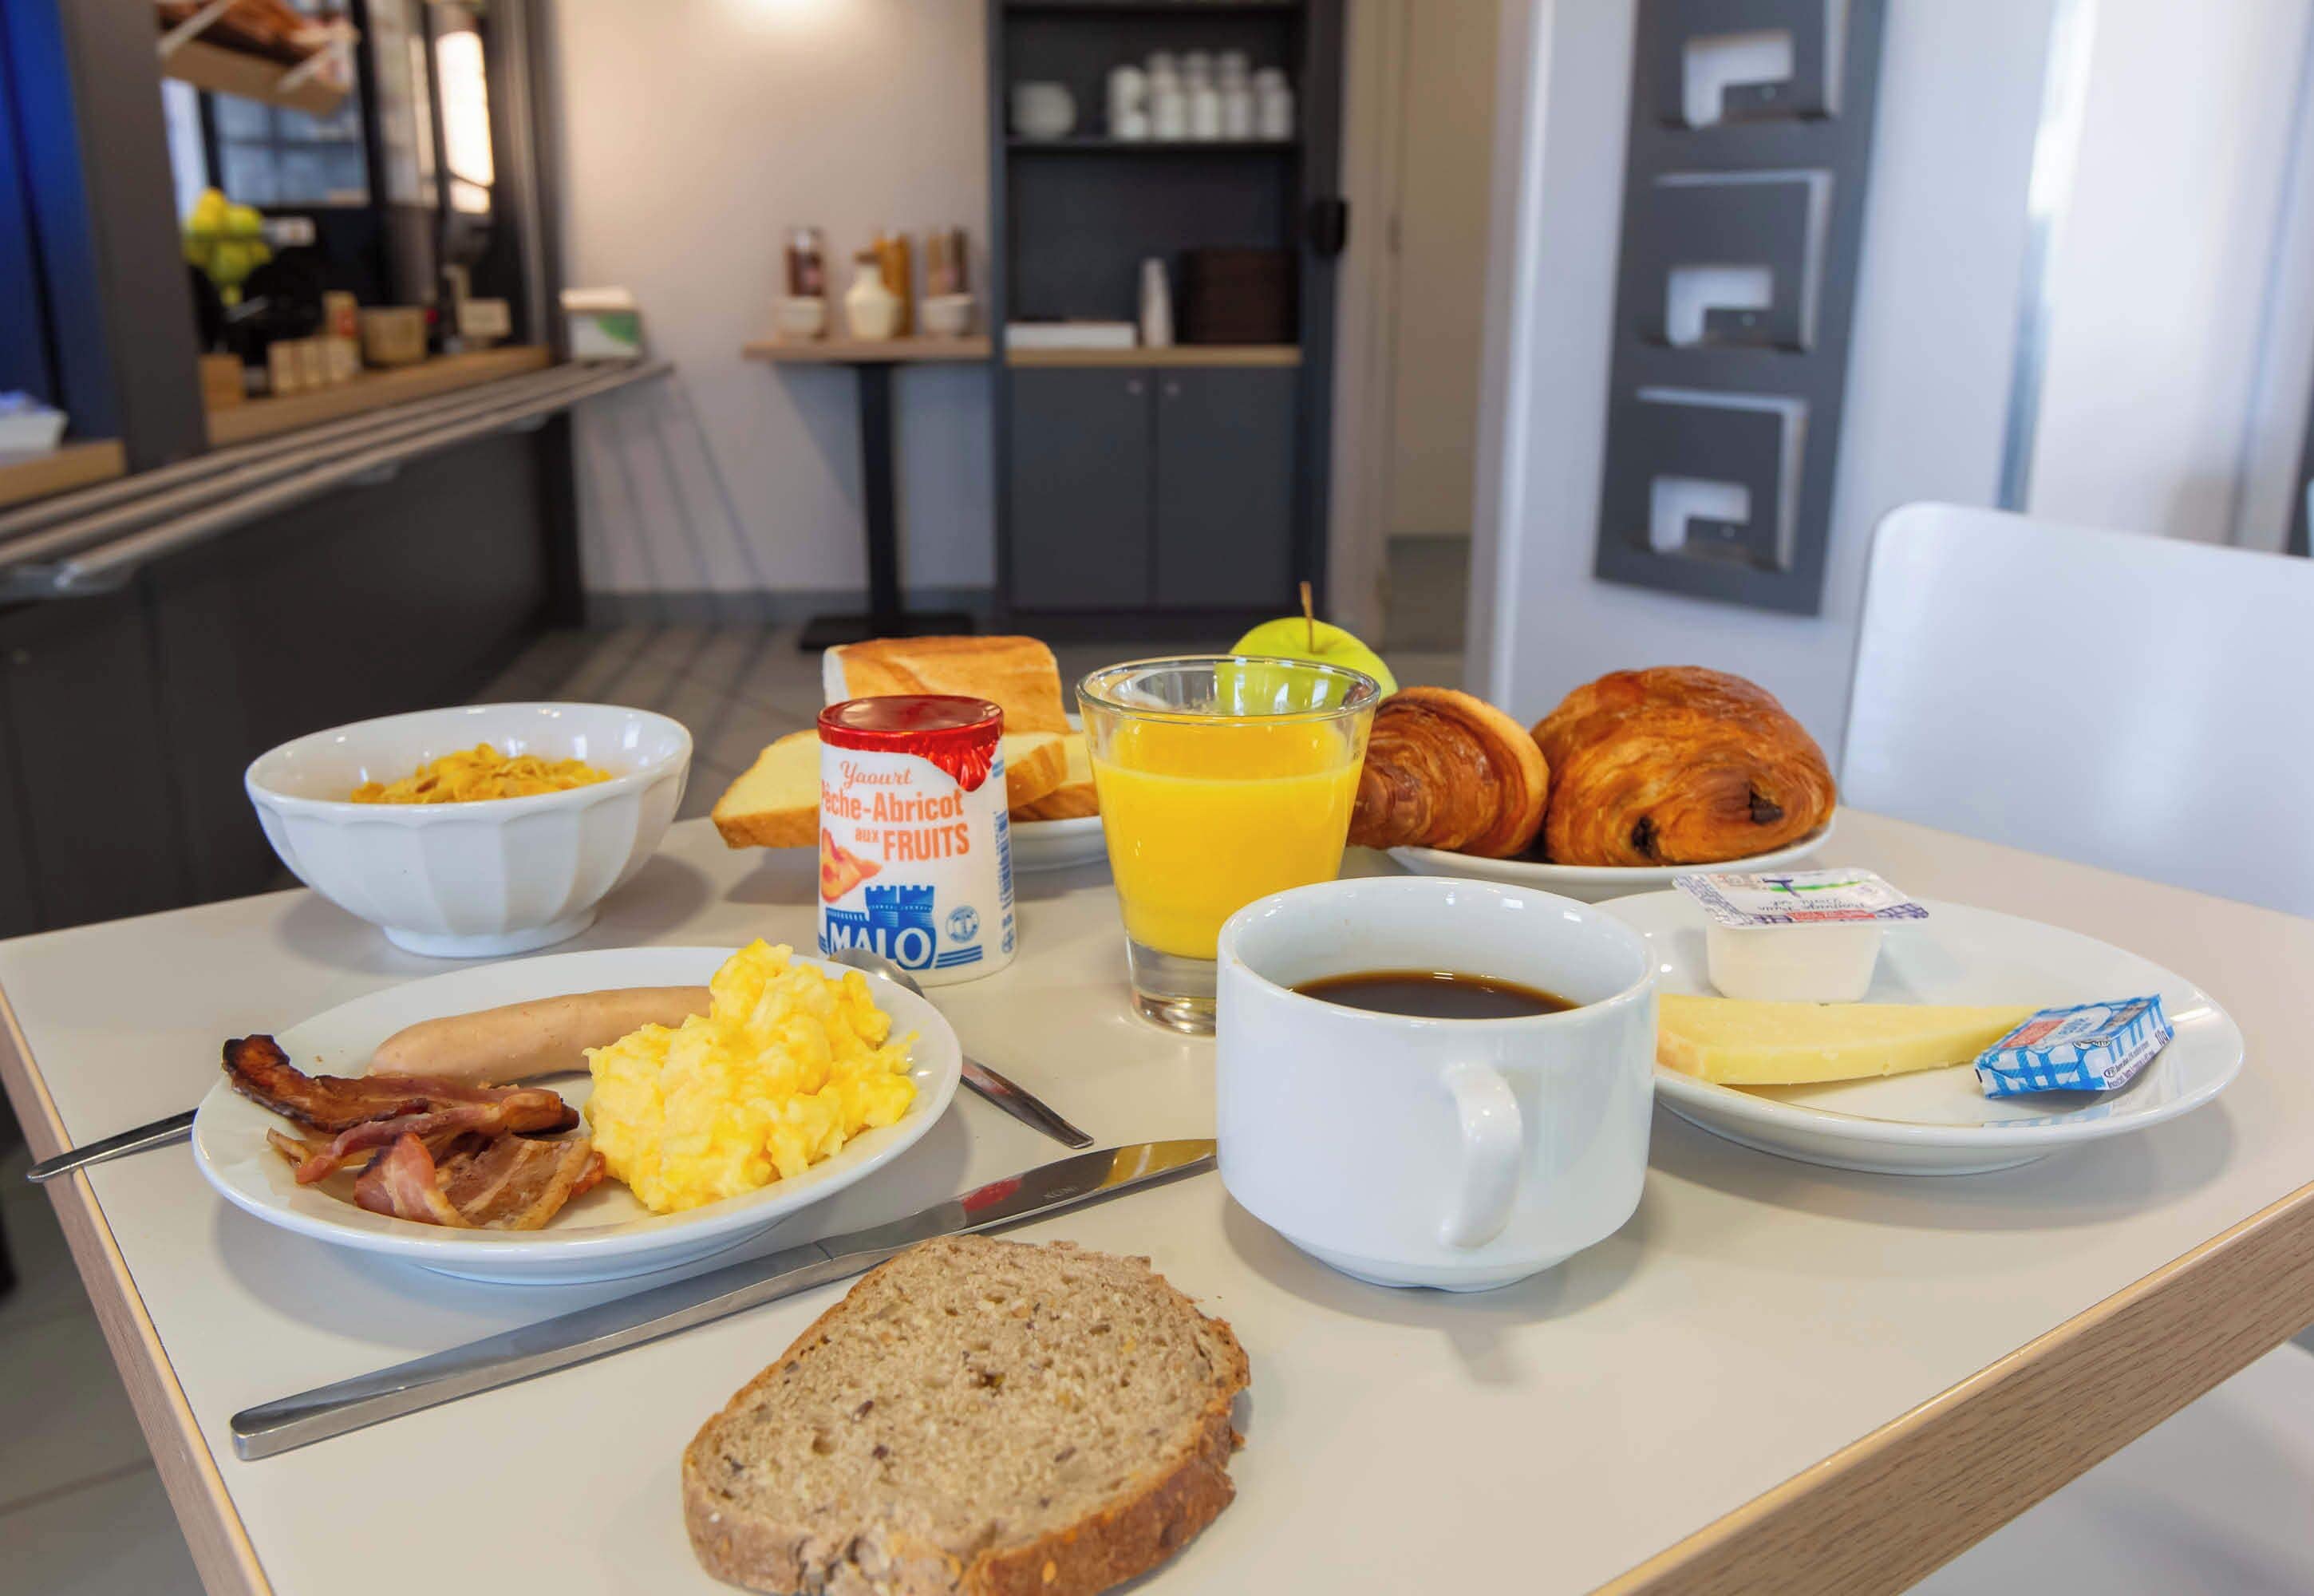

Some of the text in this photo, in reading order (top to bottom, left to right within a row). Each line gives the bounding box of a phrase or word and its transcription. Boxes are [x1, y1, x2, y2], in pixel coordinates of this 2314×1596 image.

[840, 760, 913, 789] Yaourt
[855, 823, 970, 861] aux FRUITS
[830, 922, 932, 967] MALO
